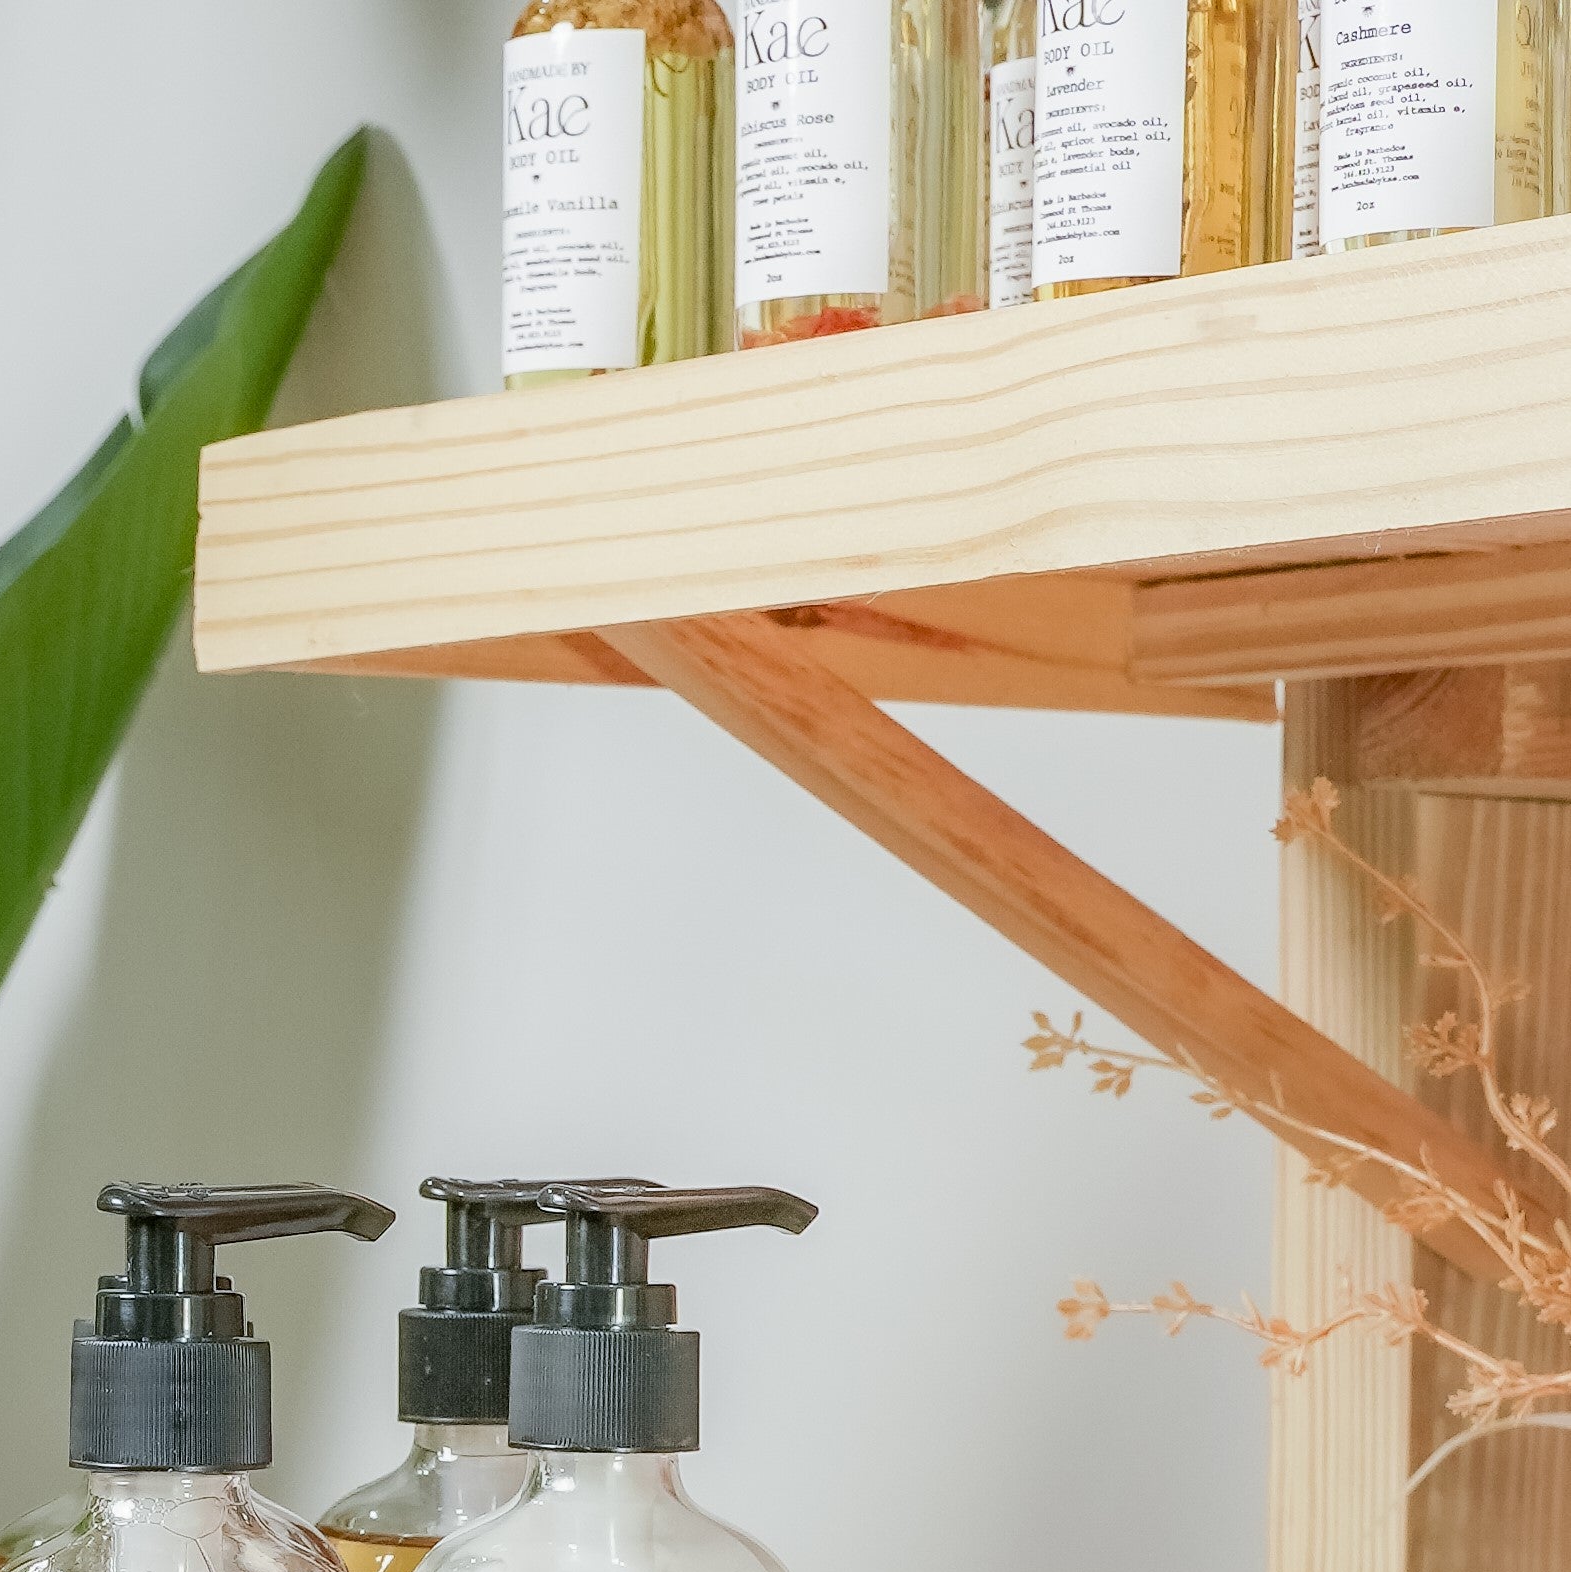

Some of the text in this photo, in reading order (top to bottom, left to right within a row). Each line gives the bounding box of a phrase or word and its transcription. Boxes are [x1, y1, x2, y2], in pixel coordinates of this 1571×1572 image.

[744, 10, 829, 69] Kae
[1335, 22, 1412, 46] Cashmere
[1044, 41, 1114, 65] BODY OIL
[1357, 67, 1430, 86] coconut oil,
[1046, 79, 1106, 98] Lavender
[1378, 77, 1474, 97] grapeseed oil,
[1400, 93, 1426, 105] oil,
[1397, 104, 1446, 117] vitamin
[797, 113, 834, 126] Rose
[1142, 117, 1168, 128] oil,
[1145, 131, 1171, 143] oil,
[1112, 161, 1131, 172] oil
[548, 197, 618, 211] Vanilla
